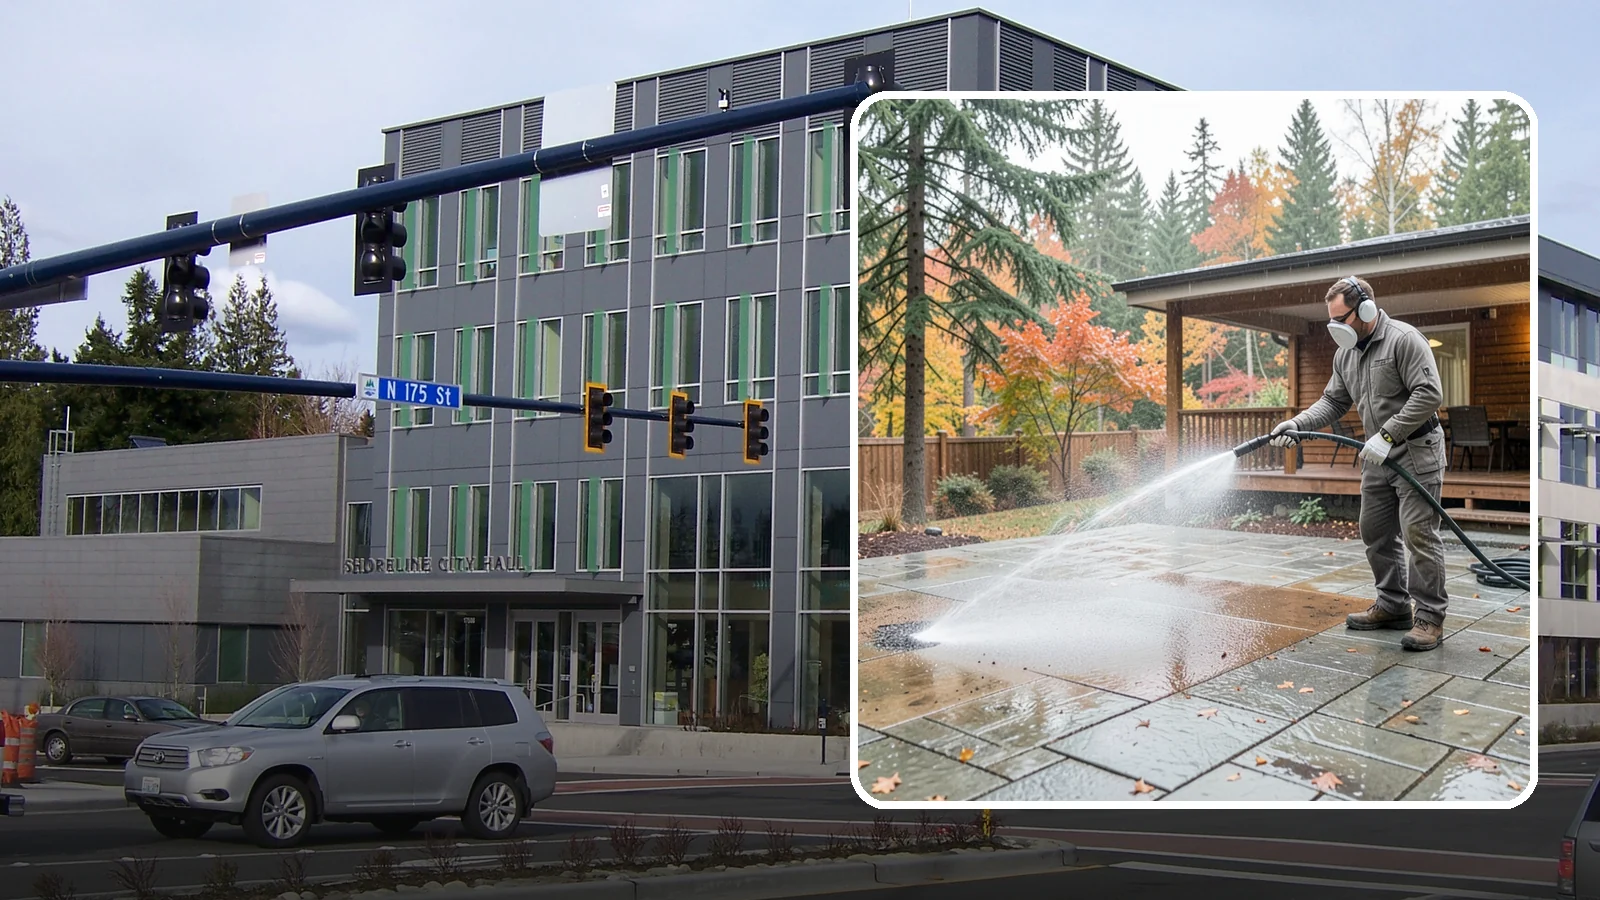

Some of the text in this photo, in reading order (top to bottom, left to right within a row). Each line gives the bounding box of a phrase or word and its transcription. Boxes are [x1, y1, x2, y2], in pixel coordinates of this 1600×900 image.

[387, 380, 451, 406] N 175 St
[344, 555, 526, 574] SHORELINE CITY HALL
